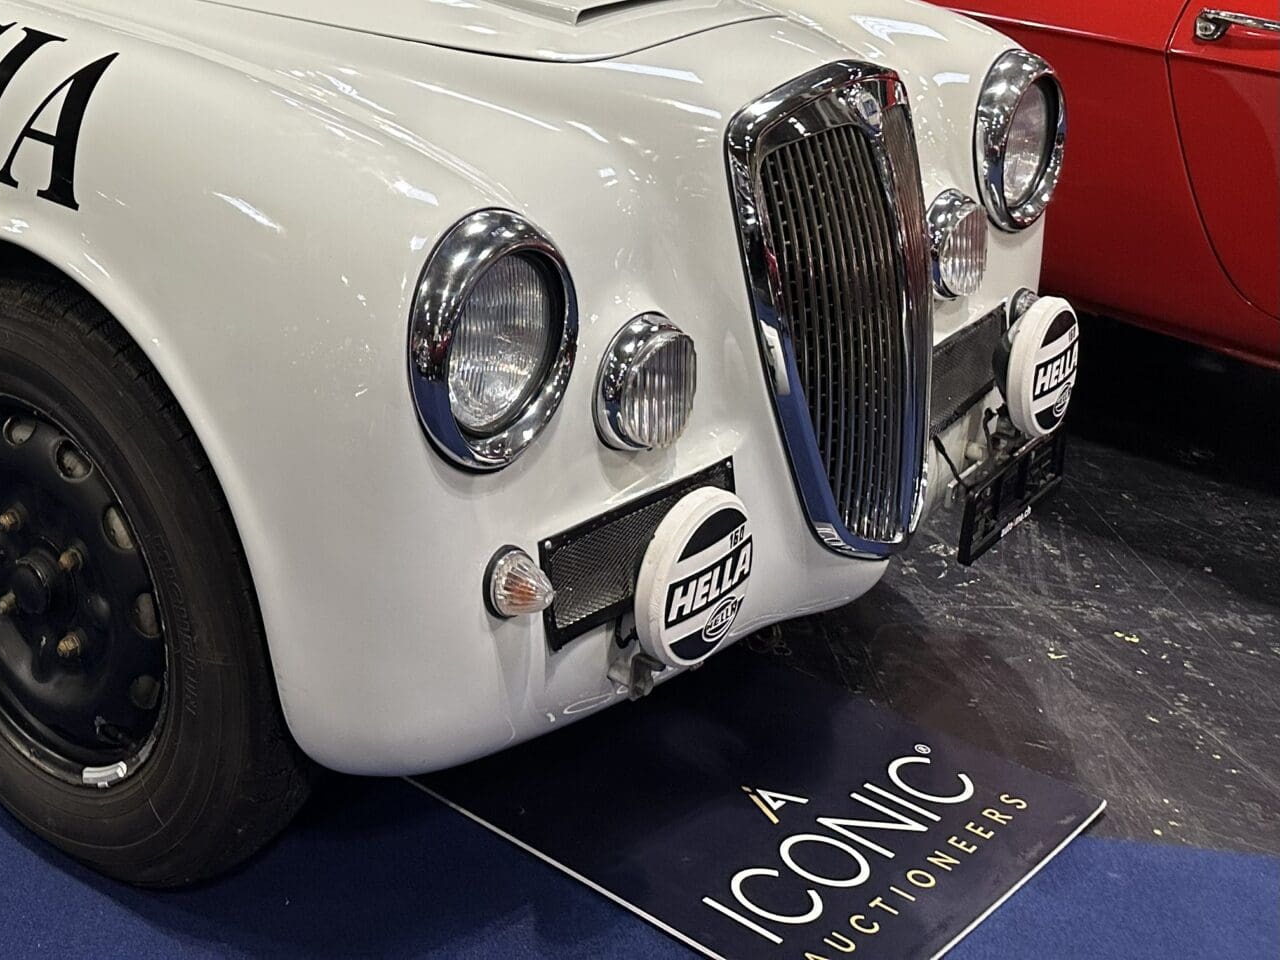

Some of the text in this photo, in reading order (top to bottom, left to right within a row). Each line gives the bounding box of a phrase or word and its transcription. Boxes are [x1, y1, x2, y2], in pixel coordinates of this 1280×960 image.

[1034, 340, 1079, 396] HELLA
[667, 542, 752, 623] HELLA
[702, 755, 975, 945] ICONIC
